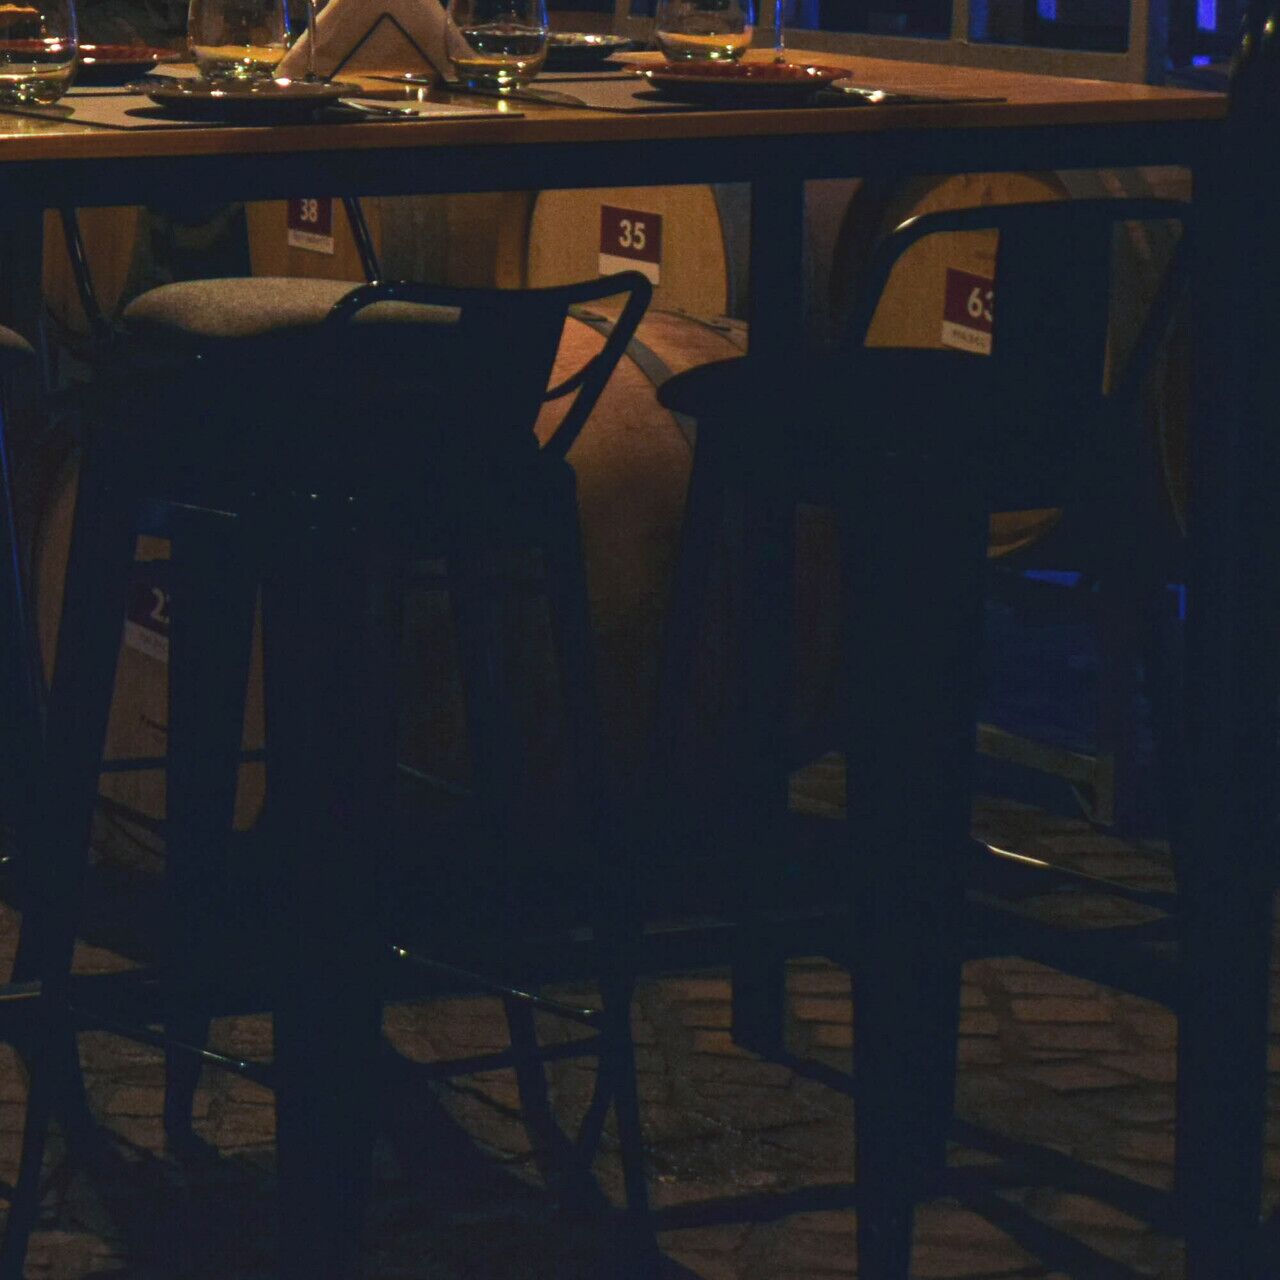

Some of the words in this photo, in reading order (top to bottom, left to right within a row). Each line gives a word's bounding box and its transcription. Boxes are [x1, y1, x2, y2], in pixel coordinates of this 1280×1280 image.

[300, 198, 318, 222] 38
[619, 218, 646, 250] 35
[150, 586, 171, 624] 2
